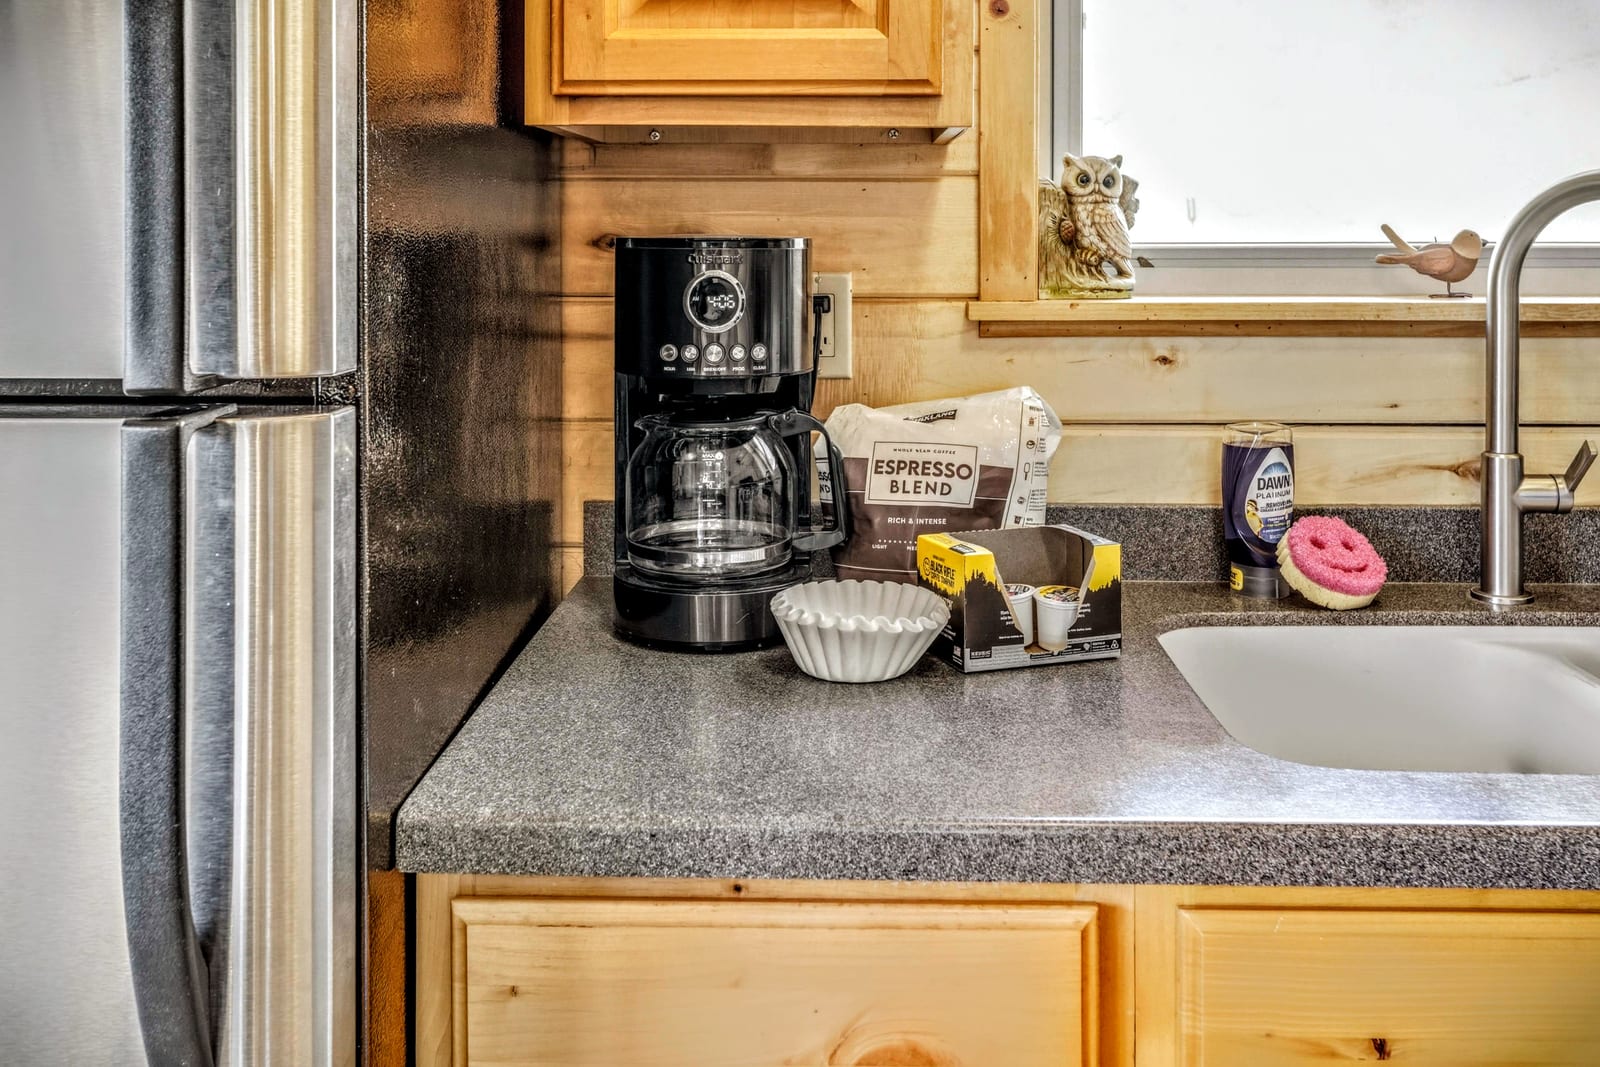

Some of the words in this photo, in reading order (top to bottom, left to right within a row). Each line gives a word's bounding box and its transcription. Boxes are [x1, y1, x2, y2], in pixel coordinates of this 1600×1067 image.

[873, 459, 973, 480] ESPRESSO
[889, 479, 952, 496] BLEND
[1257, 474, 1290, 491] DAWN
[1256, 490, 1291, 499] PLATINUM
[908, 517, 914, 525] &
